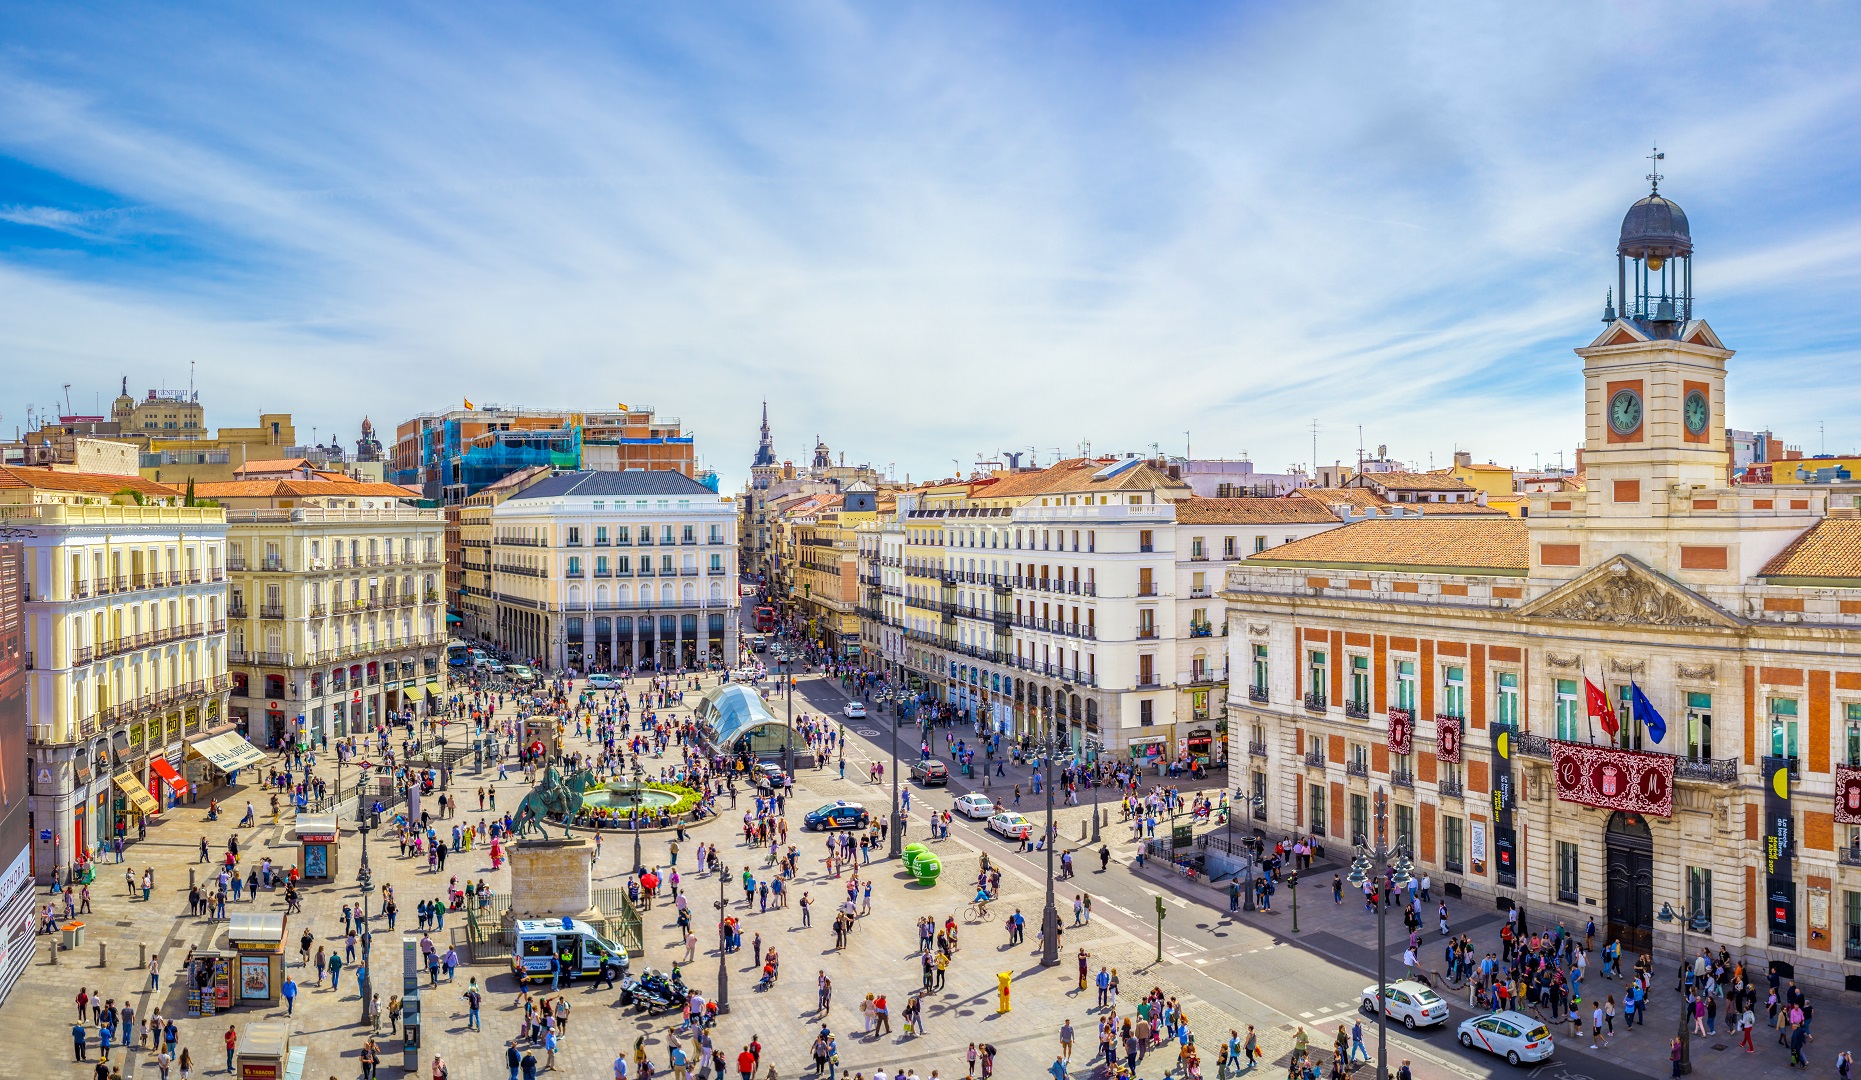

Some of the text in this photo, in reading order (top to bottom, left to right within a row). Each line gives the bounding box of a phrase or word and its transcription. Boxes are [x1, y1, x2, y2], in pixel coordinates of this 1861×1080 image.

[209, 753, 229, 764] CASA
[229, 742, 254, 757] DIEGO
[1778, 818, 1783, 826] de
[1782, 819, 1787, 827] La
[0, 861, 25, 903] SEPHORA
